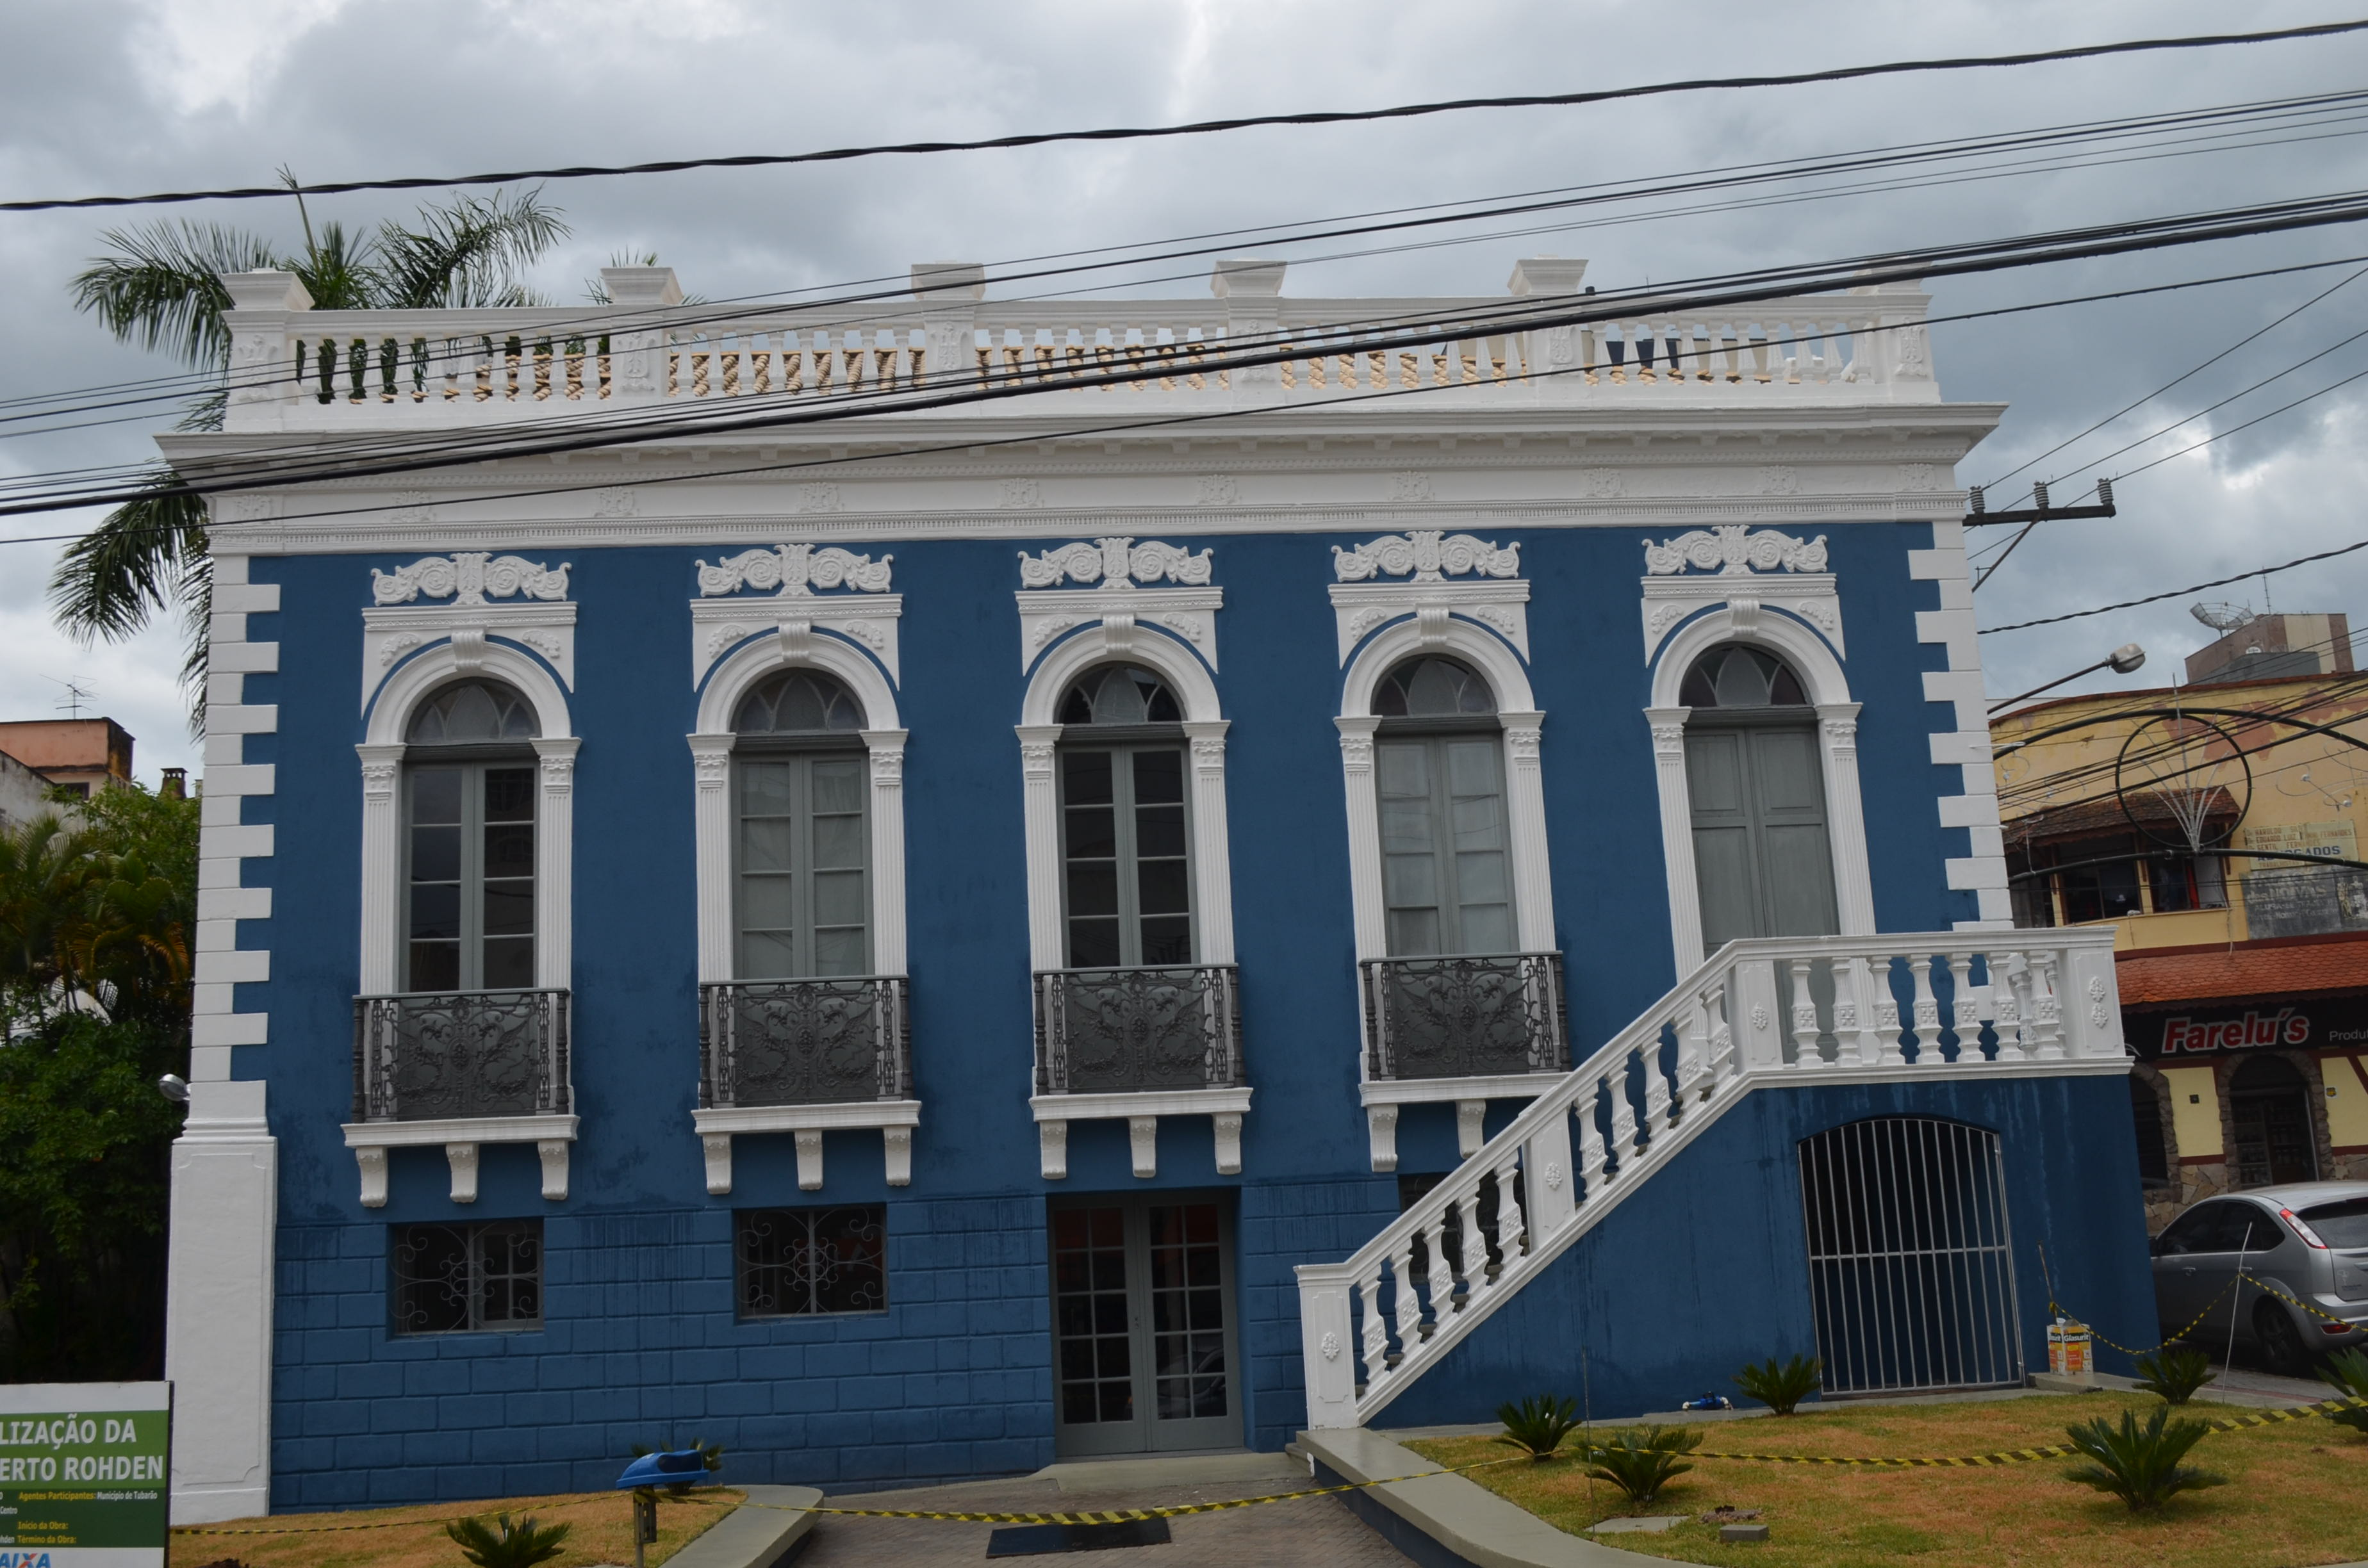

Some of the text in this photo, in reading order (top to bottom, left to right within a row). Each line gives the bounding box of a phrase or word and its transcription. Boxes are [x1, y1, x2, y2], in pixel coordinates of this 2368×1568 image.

[2162, 1007, 2368, 1054] Farelu's Produ
[0, 1412, 137, 1450] LIZAÇÃO DA
[0, 1455, 163, 1481] ERTO ROHDEN
[19, 1492, 47, 1502] Agentes
[48, 1491, 96, 1501] Participantes:
[125, 1491, 133, 1500] de
[133, 1490, 158, 1500] Tubarão
[39, 1521, 47, 1530] da
[49, 1521, 69, 1530] Obra:
[17, 1535, 76, 1544] Término da Obra:
